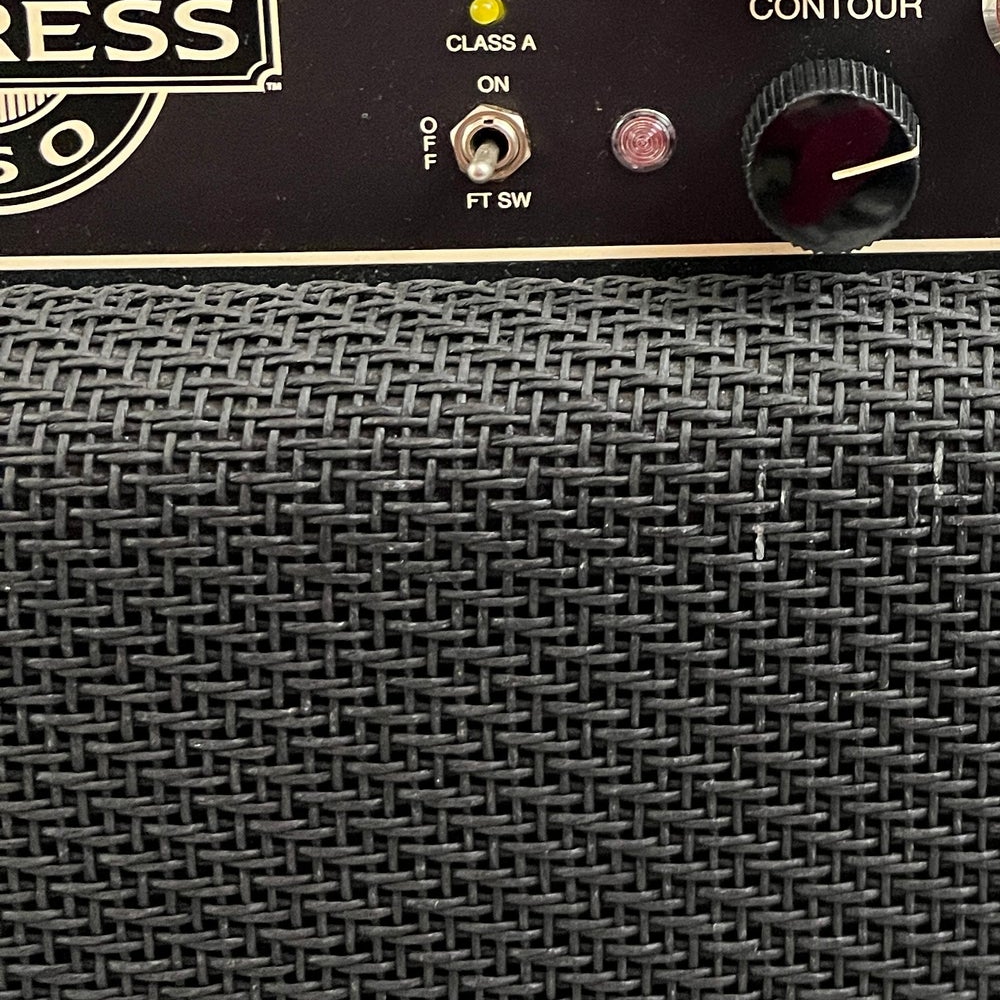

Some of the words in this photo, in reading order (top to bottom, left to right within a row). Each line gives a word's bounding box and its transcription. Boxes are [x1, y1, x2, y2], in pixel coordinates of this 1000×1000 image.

[445, 33, 517, 52] CLASS
[521, 33, 537, 52] A
[476, 75, 510, 94] ON
[419, 116, 438, 171] OFF
[466, 191, 493, 210] FT
[497, 191, 532, 209] SW
